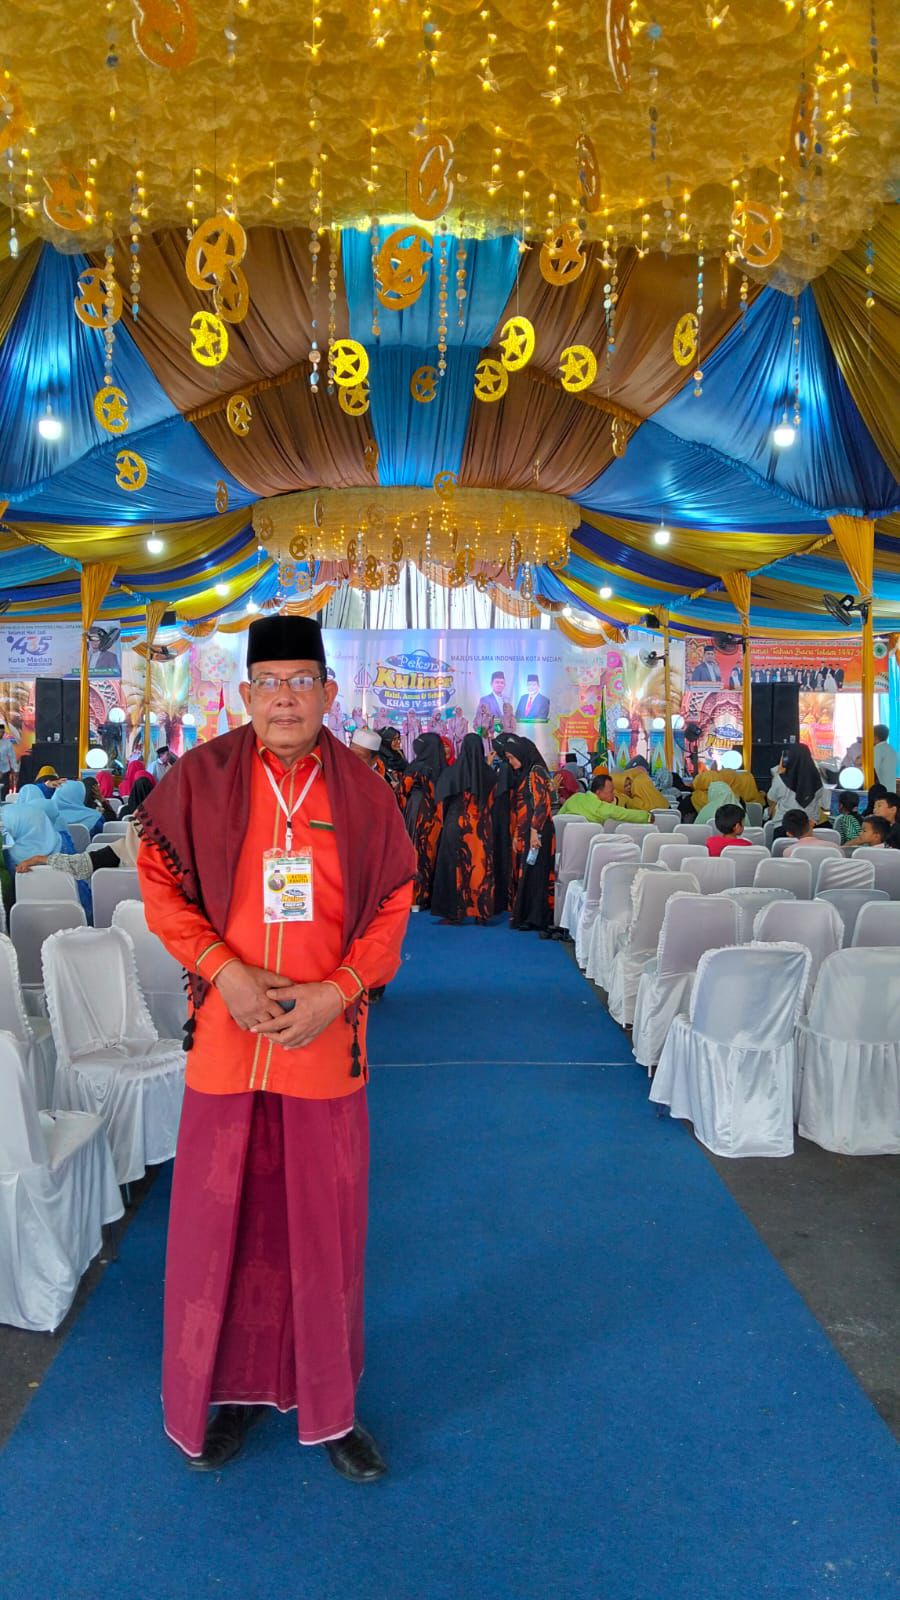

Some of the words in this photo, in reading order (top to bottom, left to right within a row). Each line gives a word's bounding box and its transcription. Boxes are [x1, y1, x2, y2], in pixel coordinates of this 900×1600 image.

[373, 666, 453, 689] Kuliner
[386, 699, 410, 707] KHAS
[411, 700, 421, 708] IV
